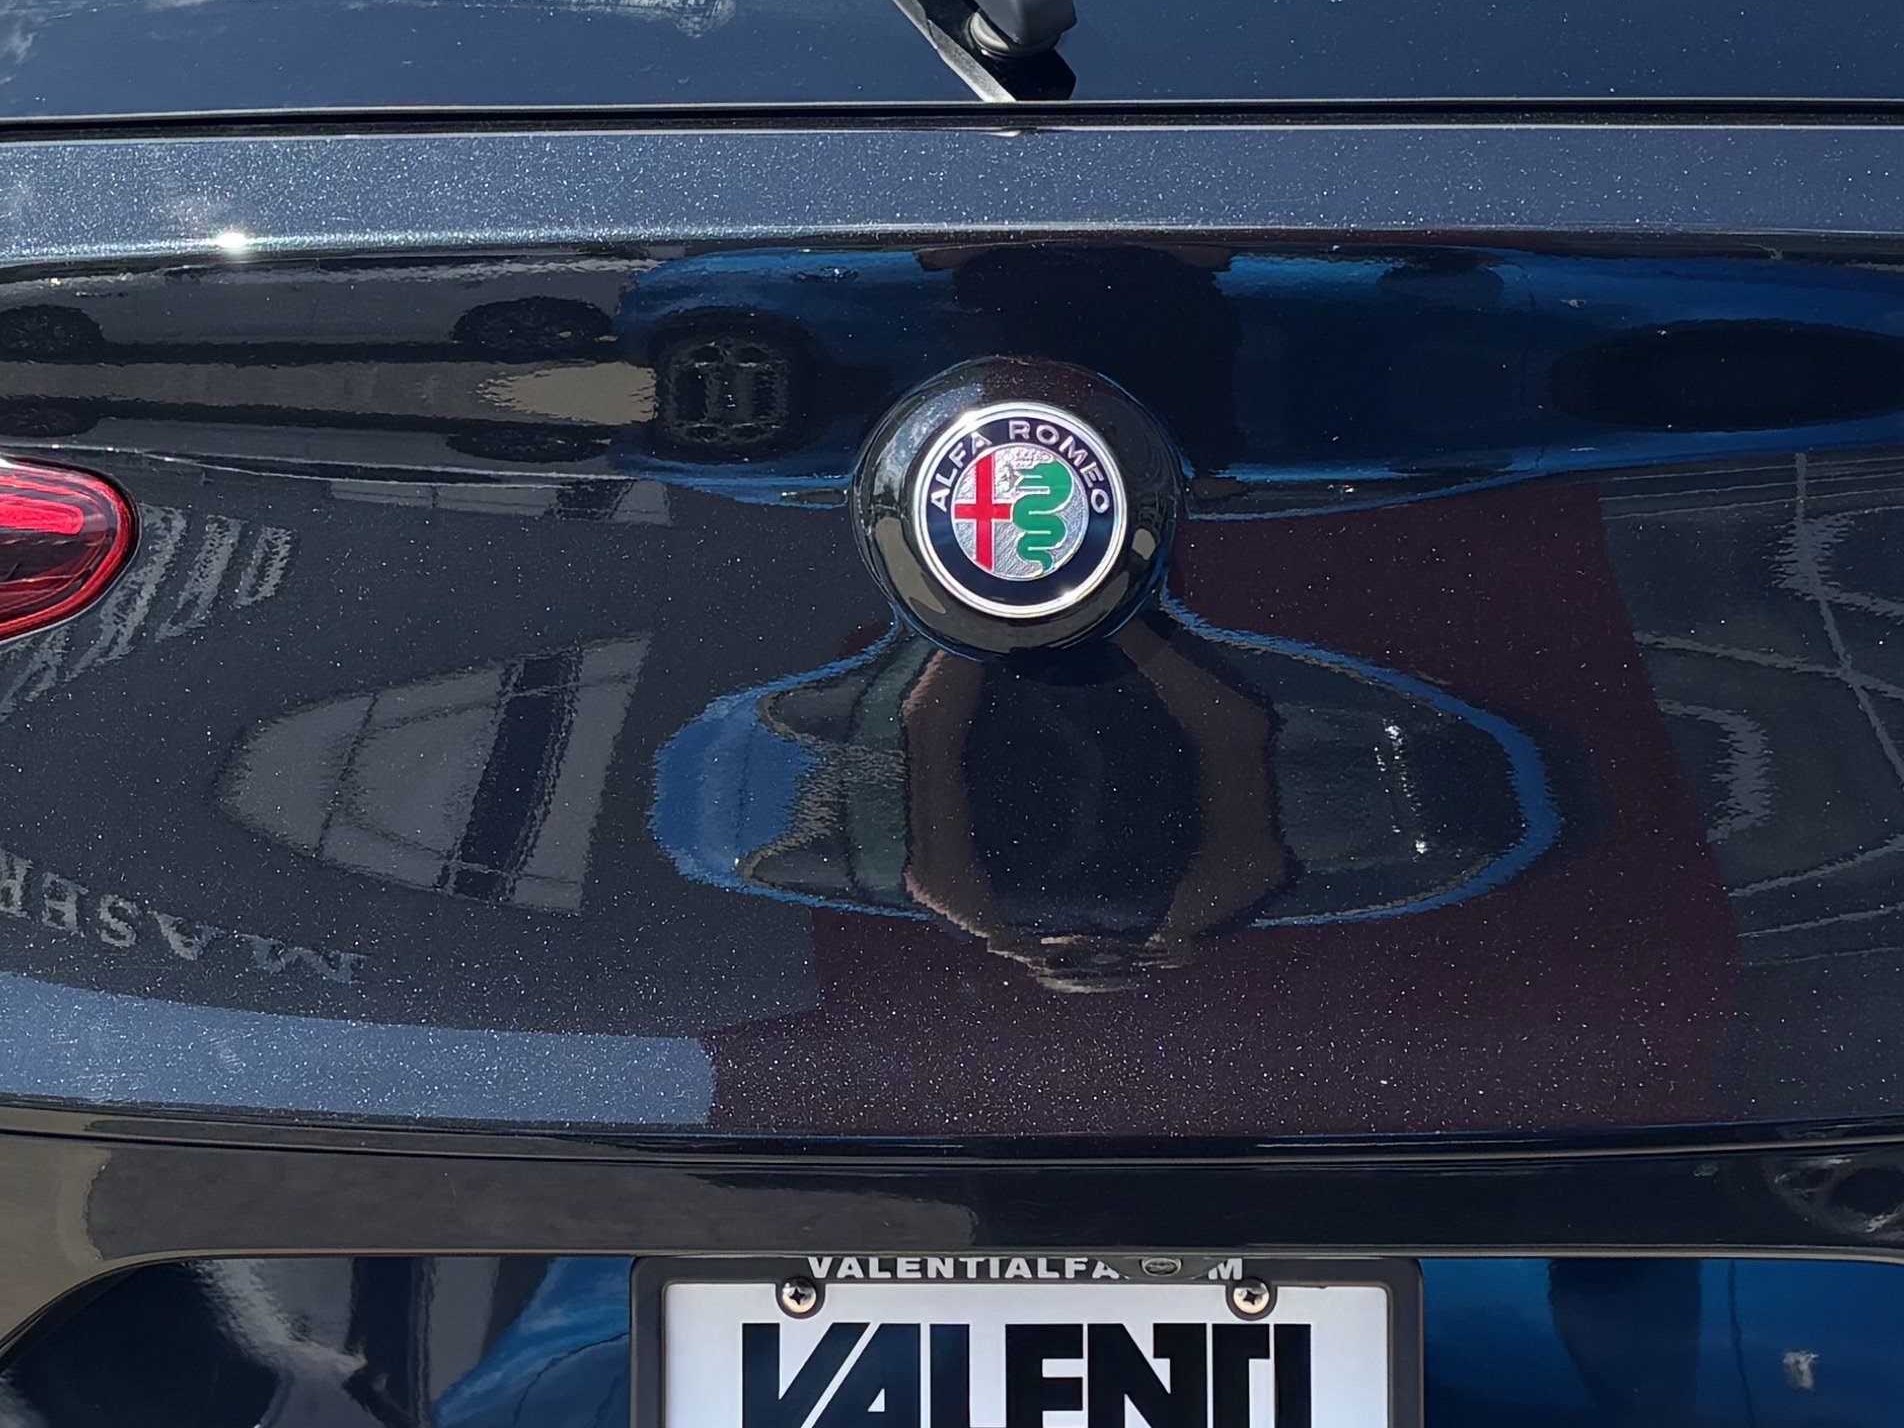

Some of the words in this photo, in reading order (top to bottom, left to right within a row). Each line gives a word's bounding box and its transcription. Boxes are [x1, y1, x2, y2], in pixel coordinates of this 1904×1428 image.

[930, 431, 992, 512] ALFA
[1008, 420, 1110, 514] ROMEO
[807, 1256, 1243, 1280] VALENTIALFAM
